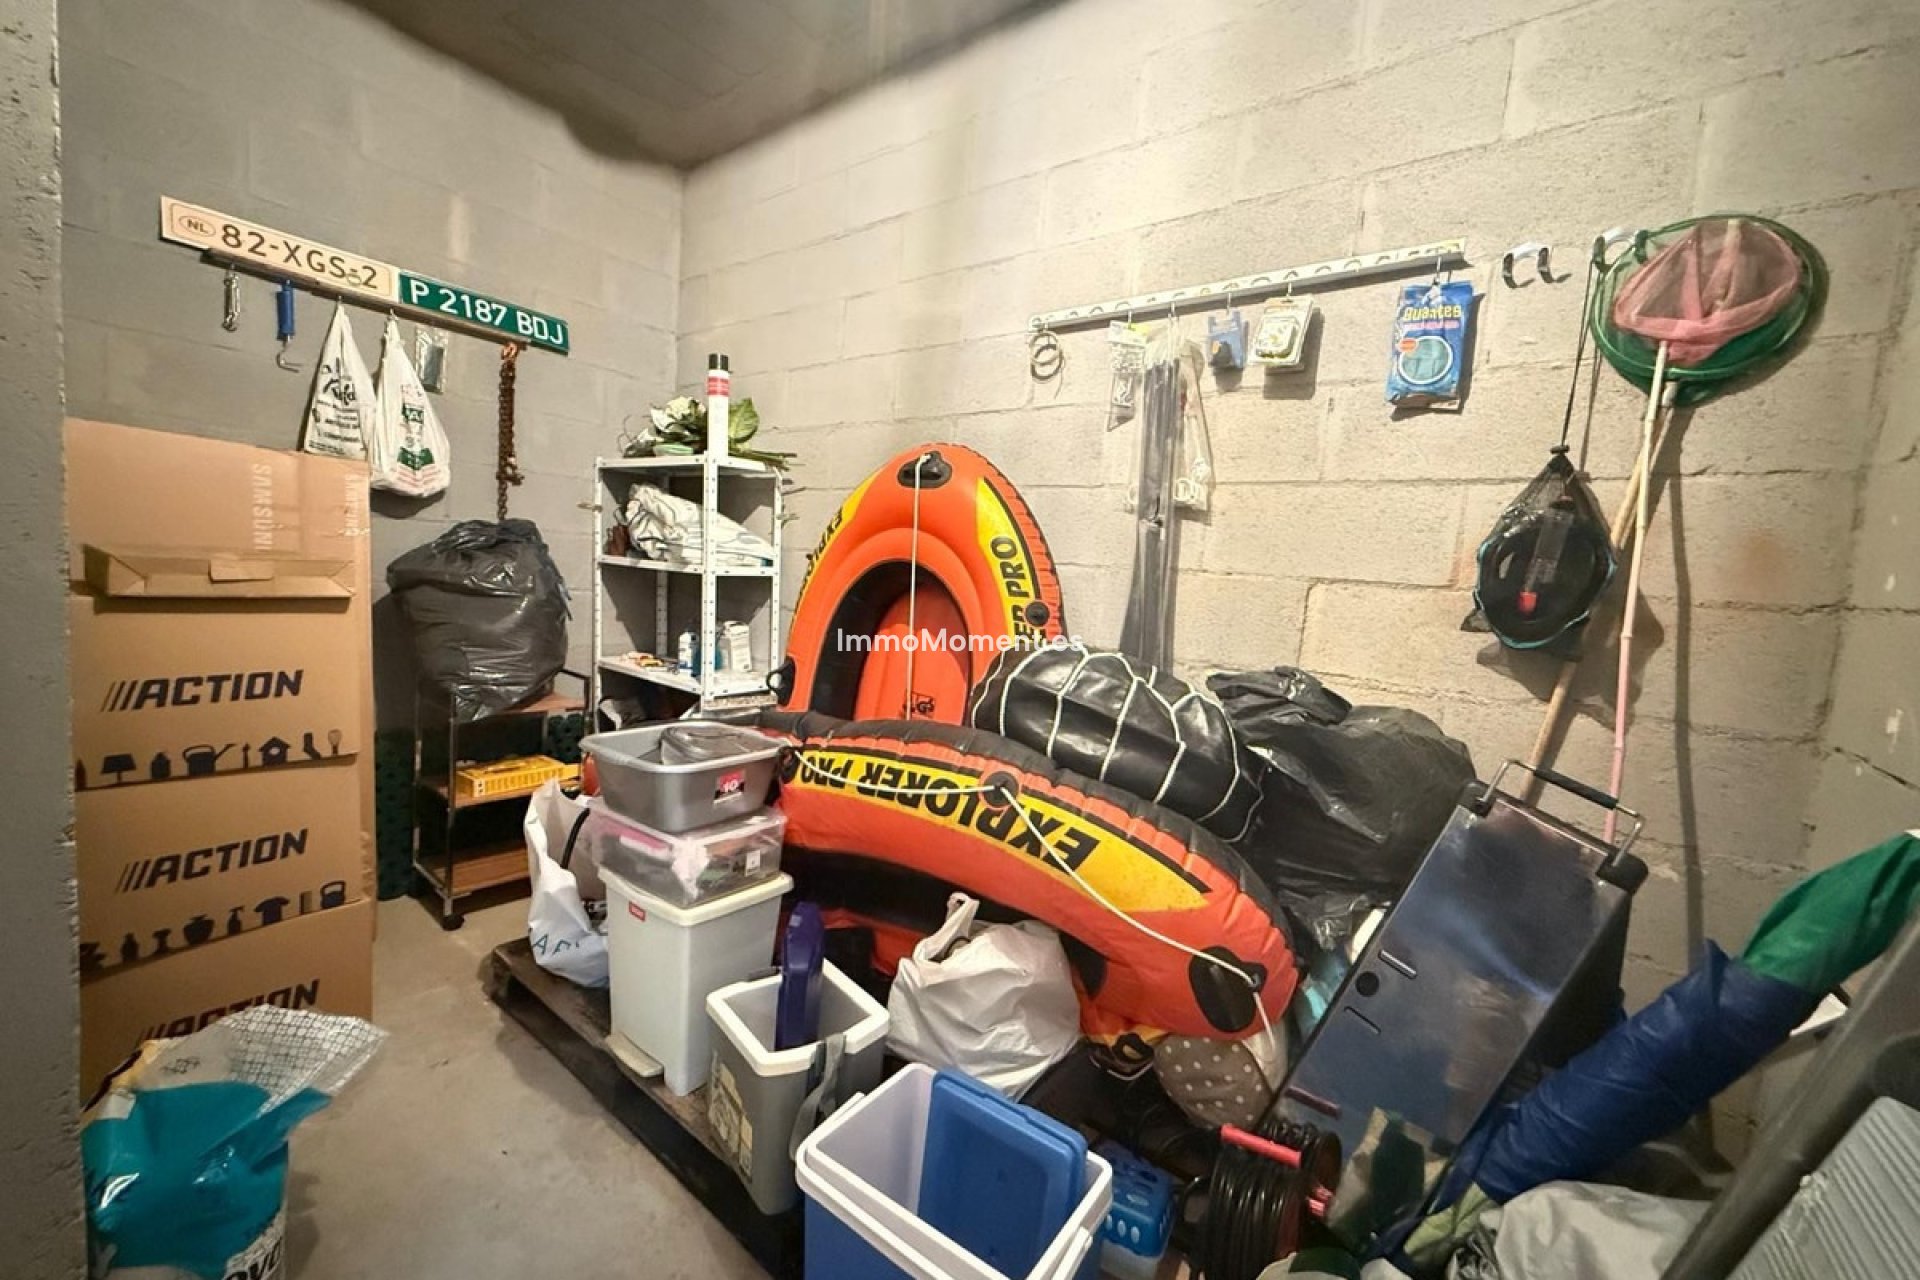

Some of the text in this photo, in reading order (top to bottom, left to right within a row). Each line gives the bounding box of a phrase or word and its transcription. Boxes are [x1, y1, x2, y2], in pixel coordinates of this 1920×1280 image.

[186, 217, 208, 233] NL
[410, 279, 564, 346] P 2187 BDJ
[990, 537, 1029, 598] PRO
[132, 669, 304, 711] ACTION
[801, 755, 854, 788] PRO
[145, 829, 308, 888] ACTION
